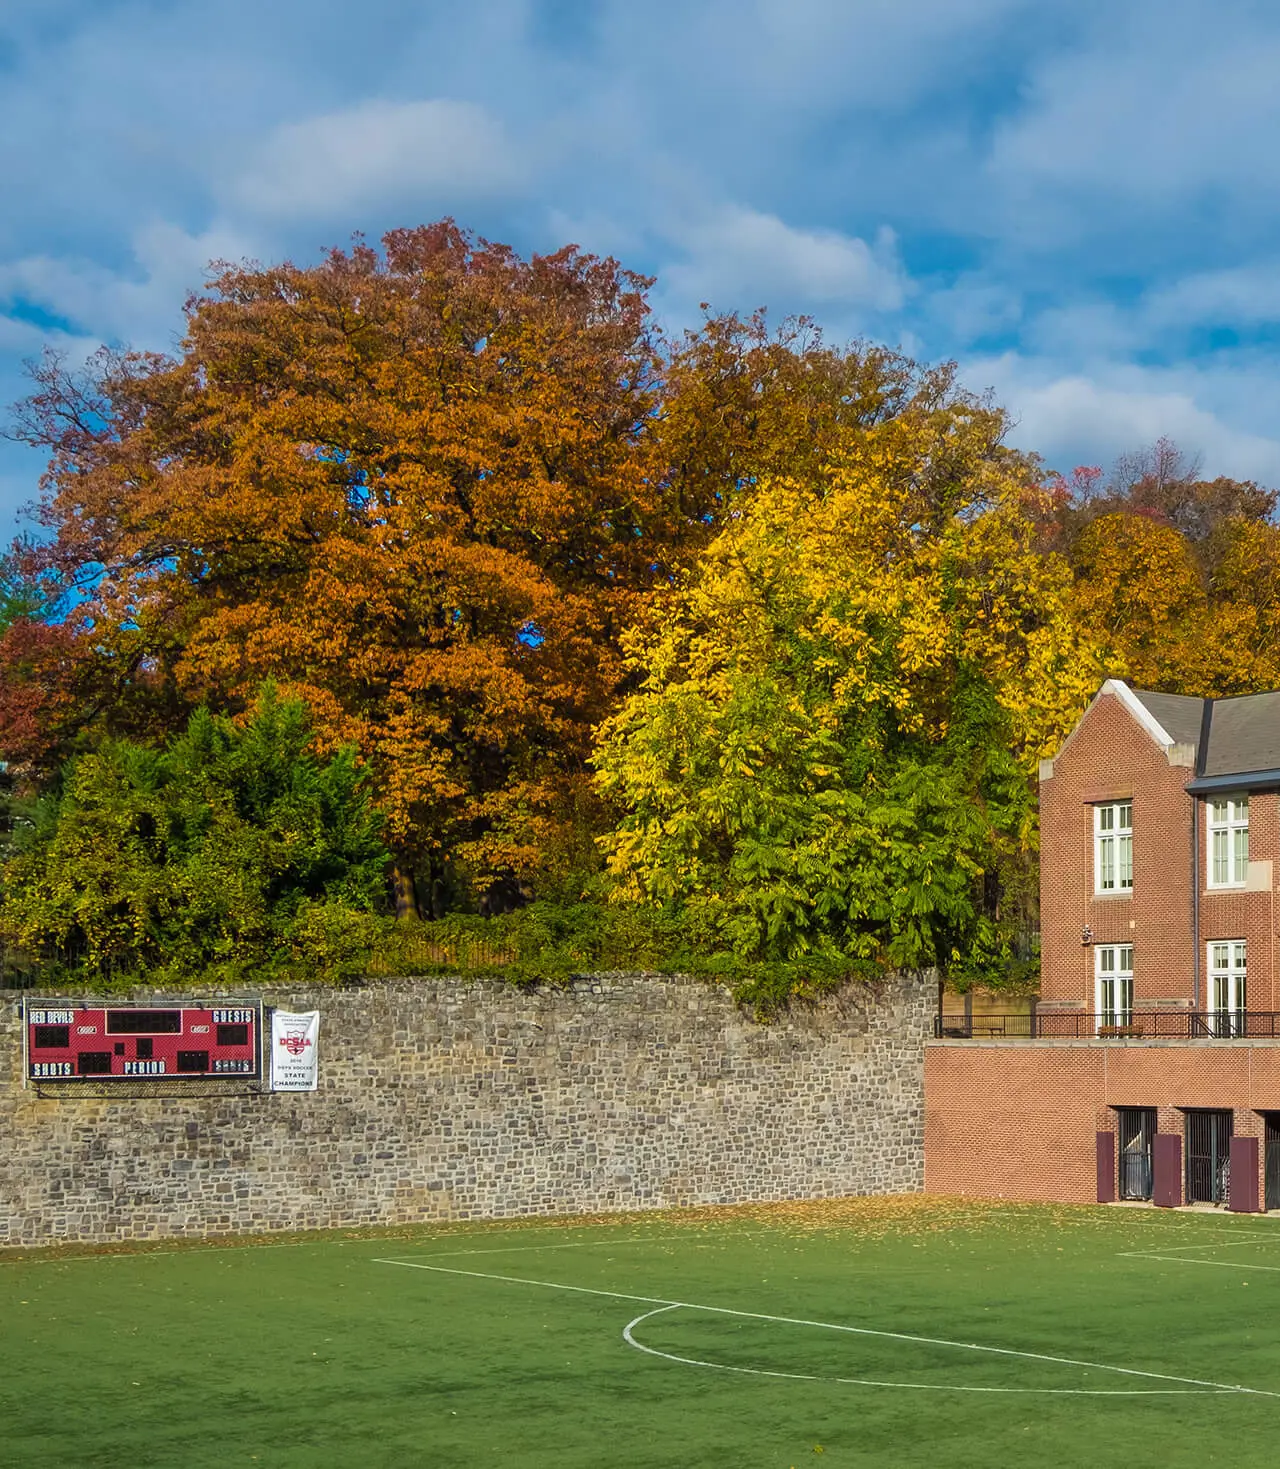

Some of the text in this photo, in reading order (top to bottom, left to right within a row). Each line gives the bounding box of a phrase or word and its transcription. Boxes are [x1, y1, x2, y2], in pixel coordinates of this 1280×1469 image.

[30, 1011, 74, 1024] RED DEVILS
[213, 1010, 251, 1023] GUESTS
[279, 1037, 312, 1047] DCSAA
[34, 1062, 71, 1076] SHOTS
[124, 1061, 165, 1075] PERIOD
